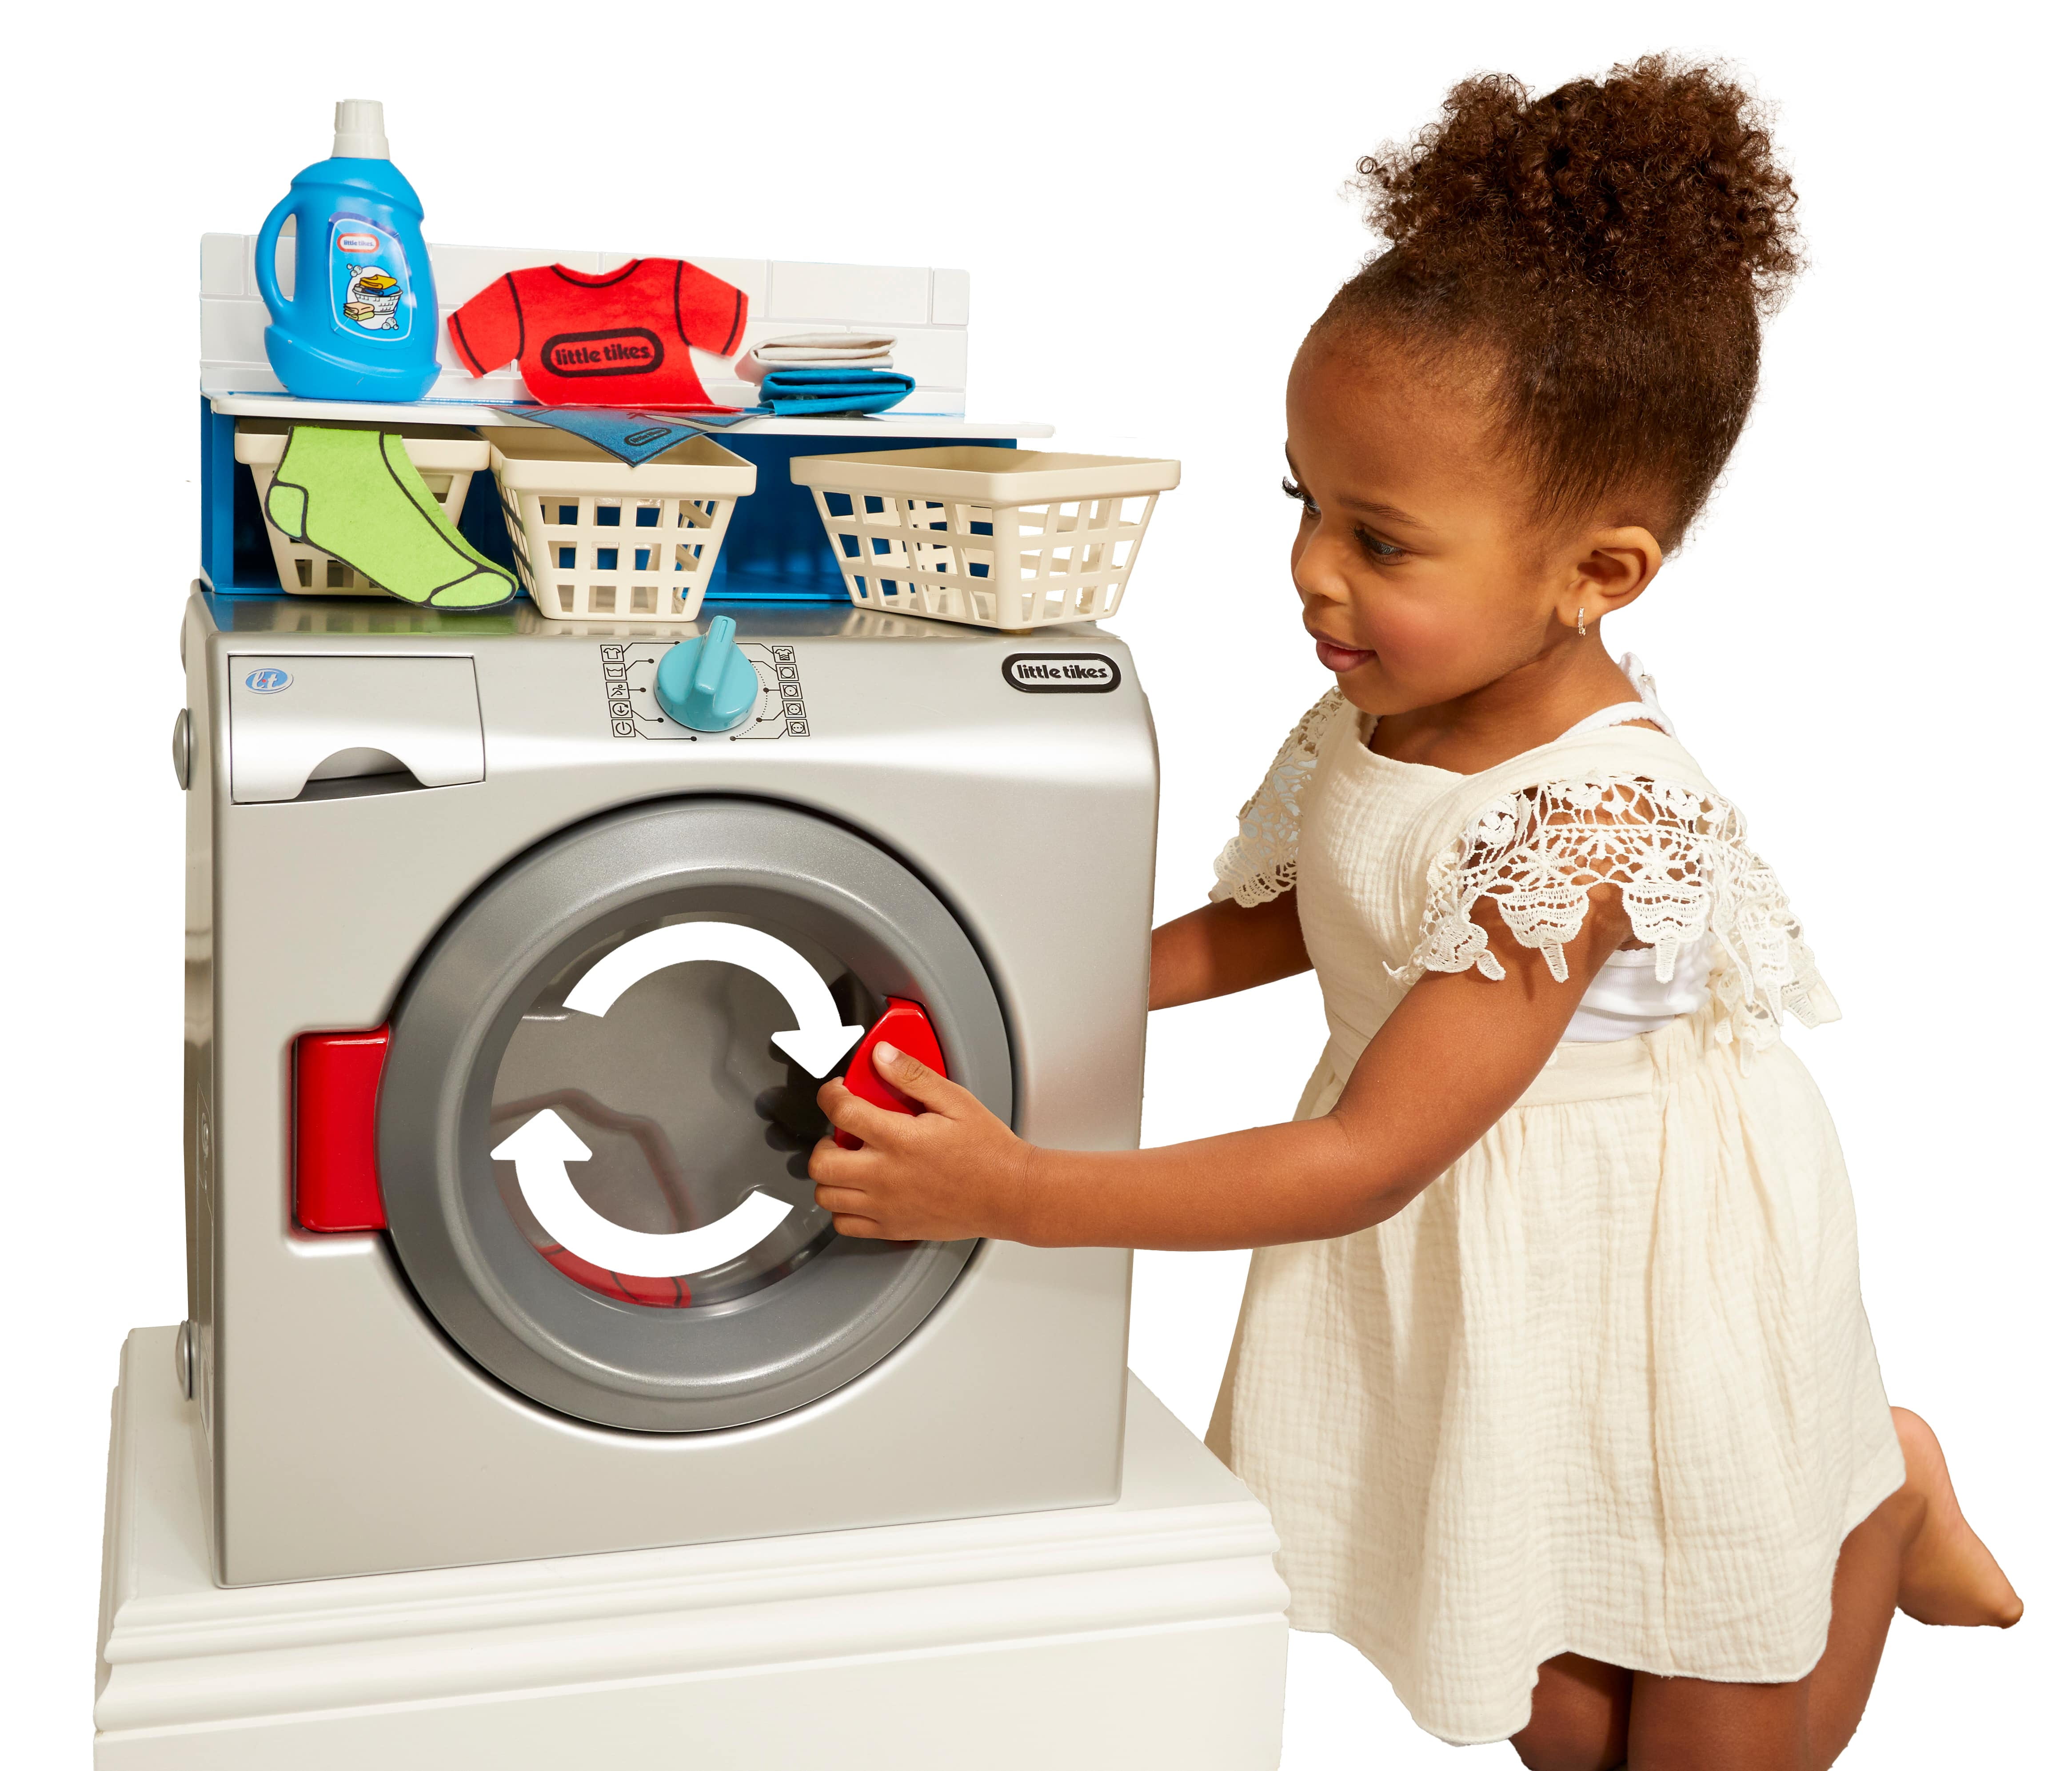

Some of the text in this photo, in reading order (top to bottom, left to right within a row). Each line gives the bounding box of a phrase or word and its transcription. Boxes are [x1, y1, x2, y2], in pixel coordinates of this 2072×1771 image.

[555, 343, 651, 365] little tikes
[1017, 664, 1107, 678] little tikes
